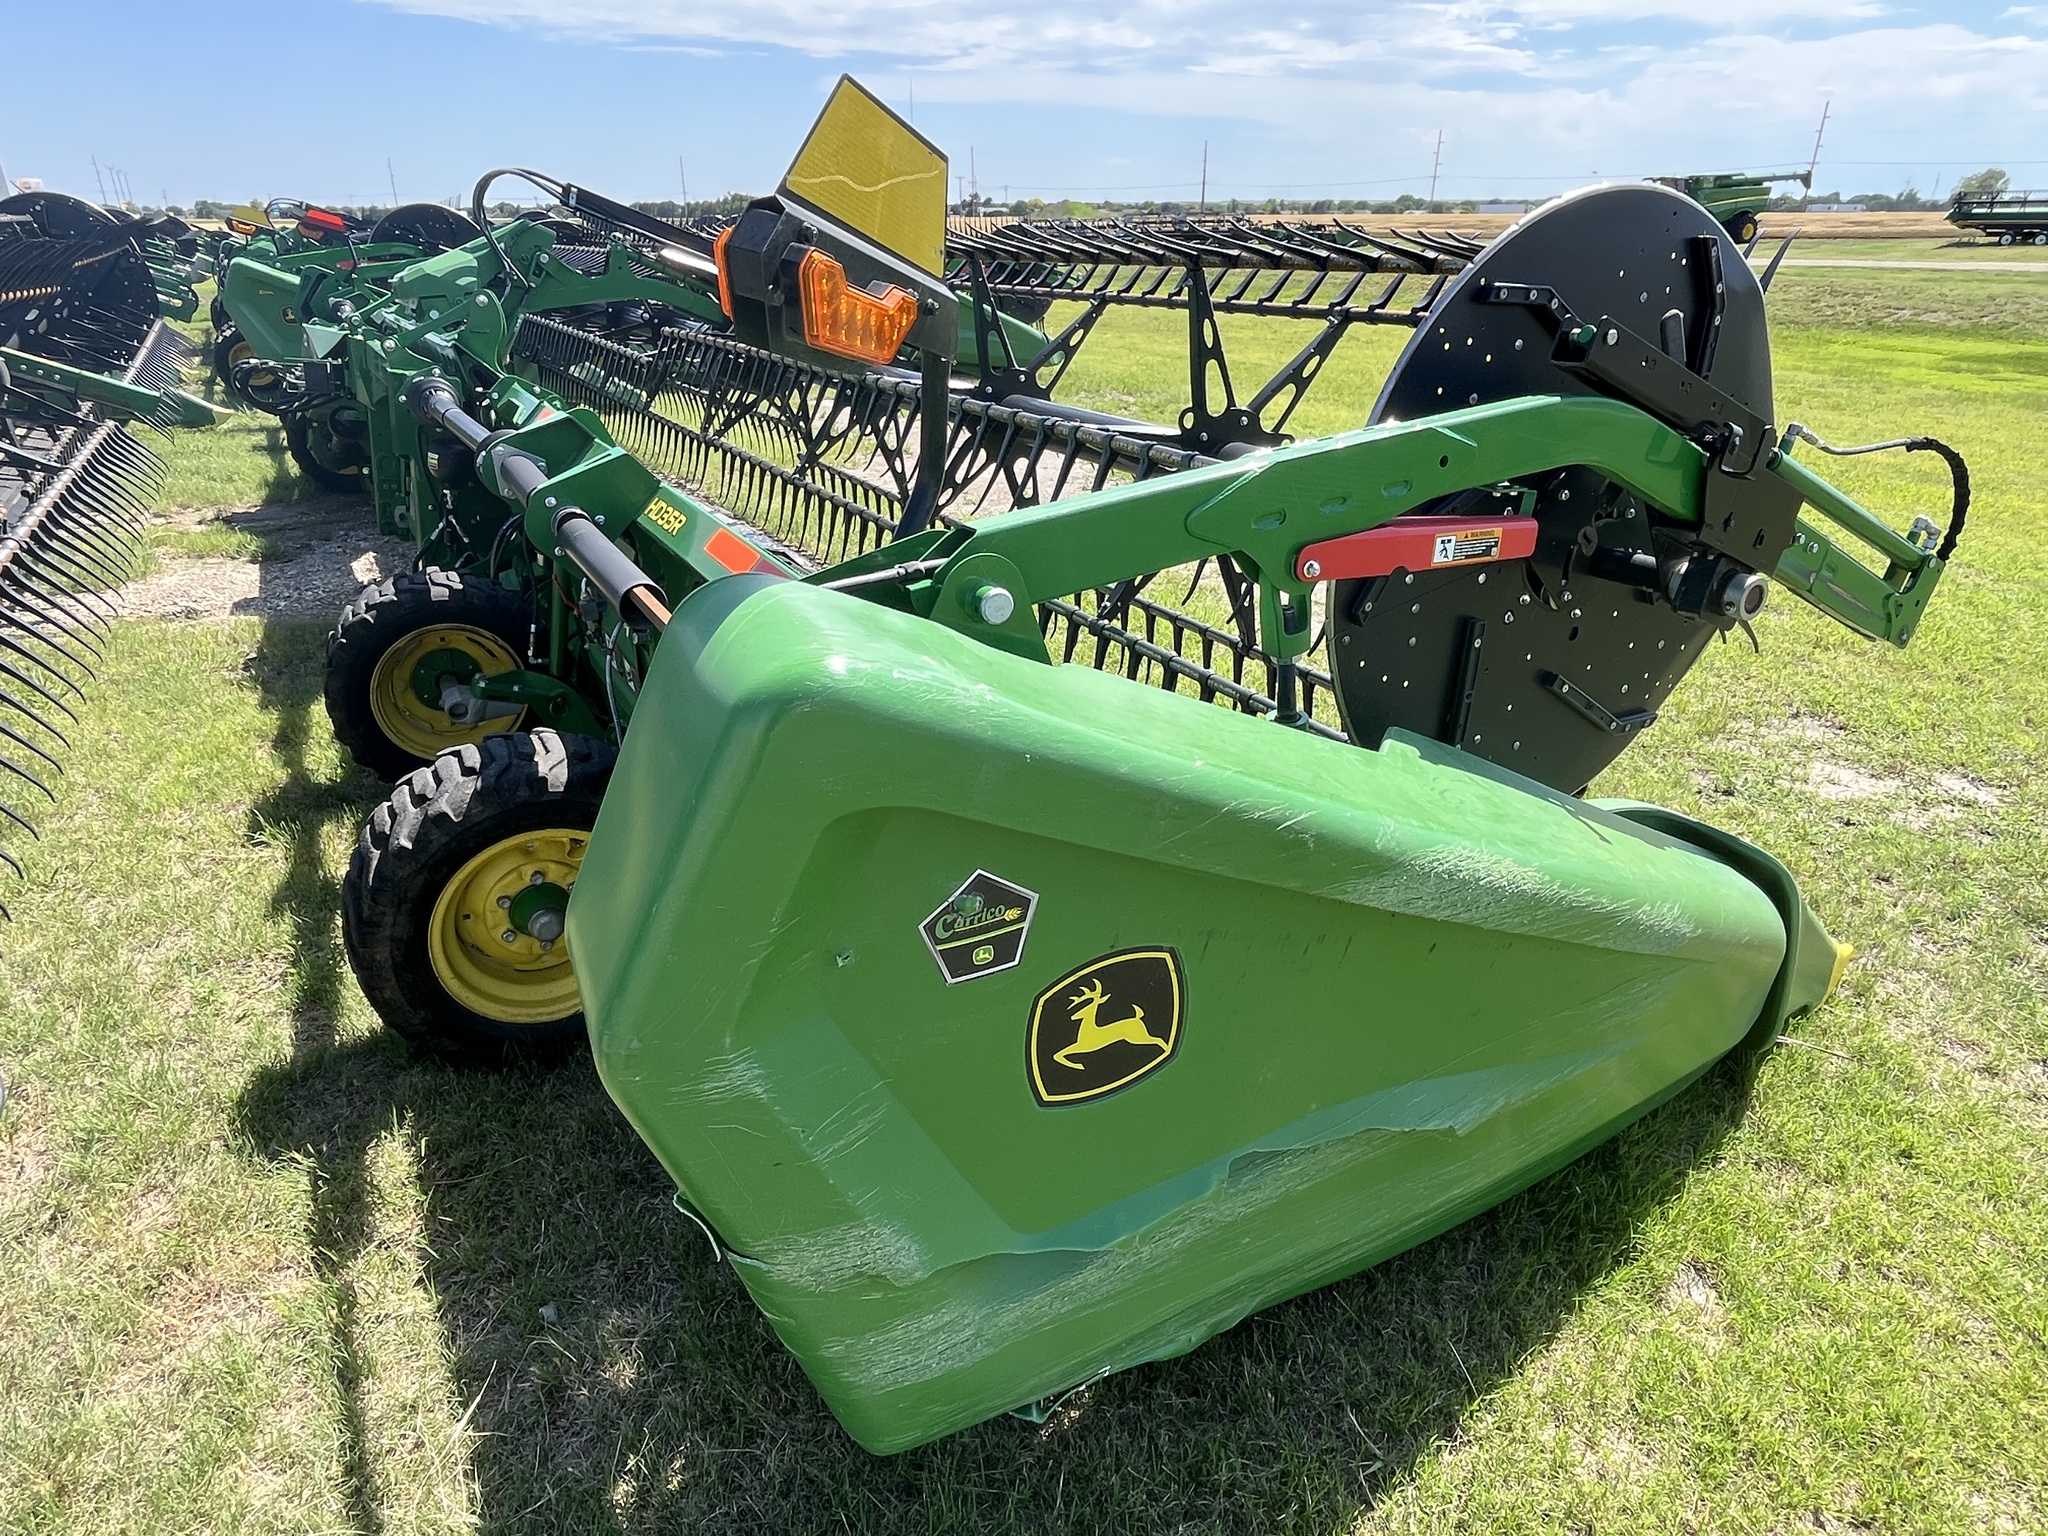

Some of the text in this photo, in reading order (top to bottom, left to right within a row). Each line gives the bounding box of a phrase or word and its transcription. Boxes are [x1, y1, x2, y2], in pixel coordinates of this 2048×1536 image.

[643, 497, 687, 536] HD35R
[1470, 529, 1496, 538] WARNING
[935, 904, 1006, 939] Carrico
